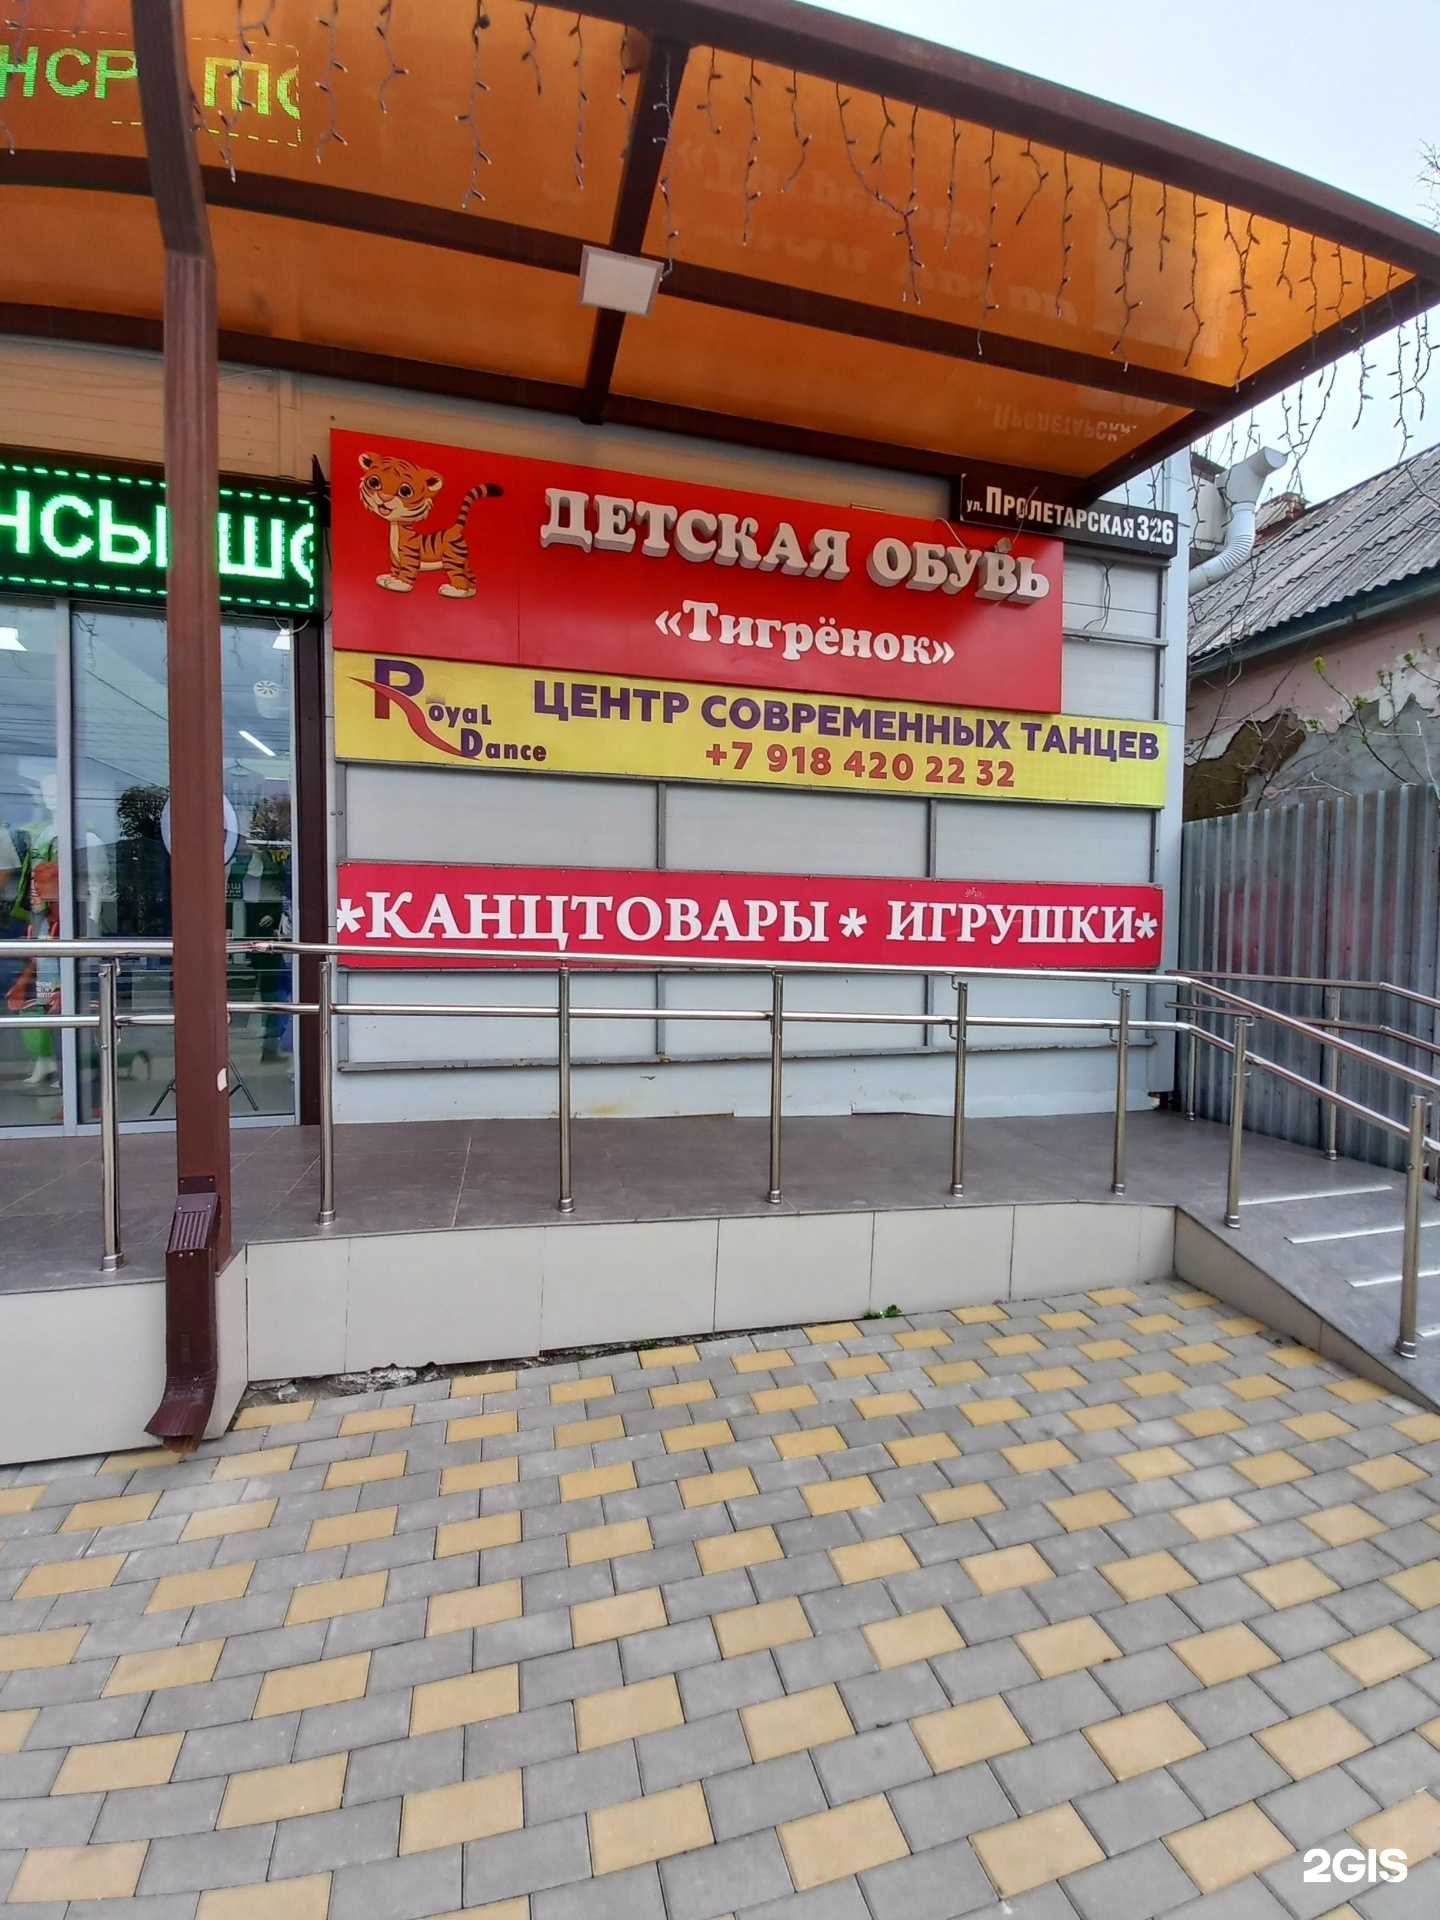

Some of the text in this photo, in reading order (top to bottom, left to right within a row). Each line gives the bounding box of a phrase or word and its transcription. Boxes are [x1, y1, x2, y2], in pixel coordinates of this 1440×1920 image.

[540, 487, 1050, 605] ДЕТСКАЯ ОБУВЬ
[966, 498, 983, 512] ул.
[1136, 514, 1174, 545] 326
[655, 600, 955, 665] «Тигрёнок»
[460, 728, 547, 761] Dance
[534, 680, 1160, 762] ЦЕНТР СОВРЕМЕННЫХ ТАНЦЕВ
[705, 741, 1015, 787] +7 918 420 22 32
